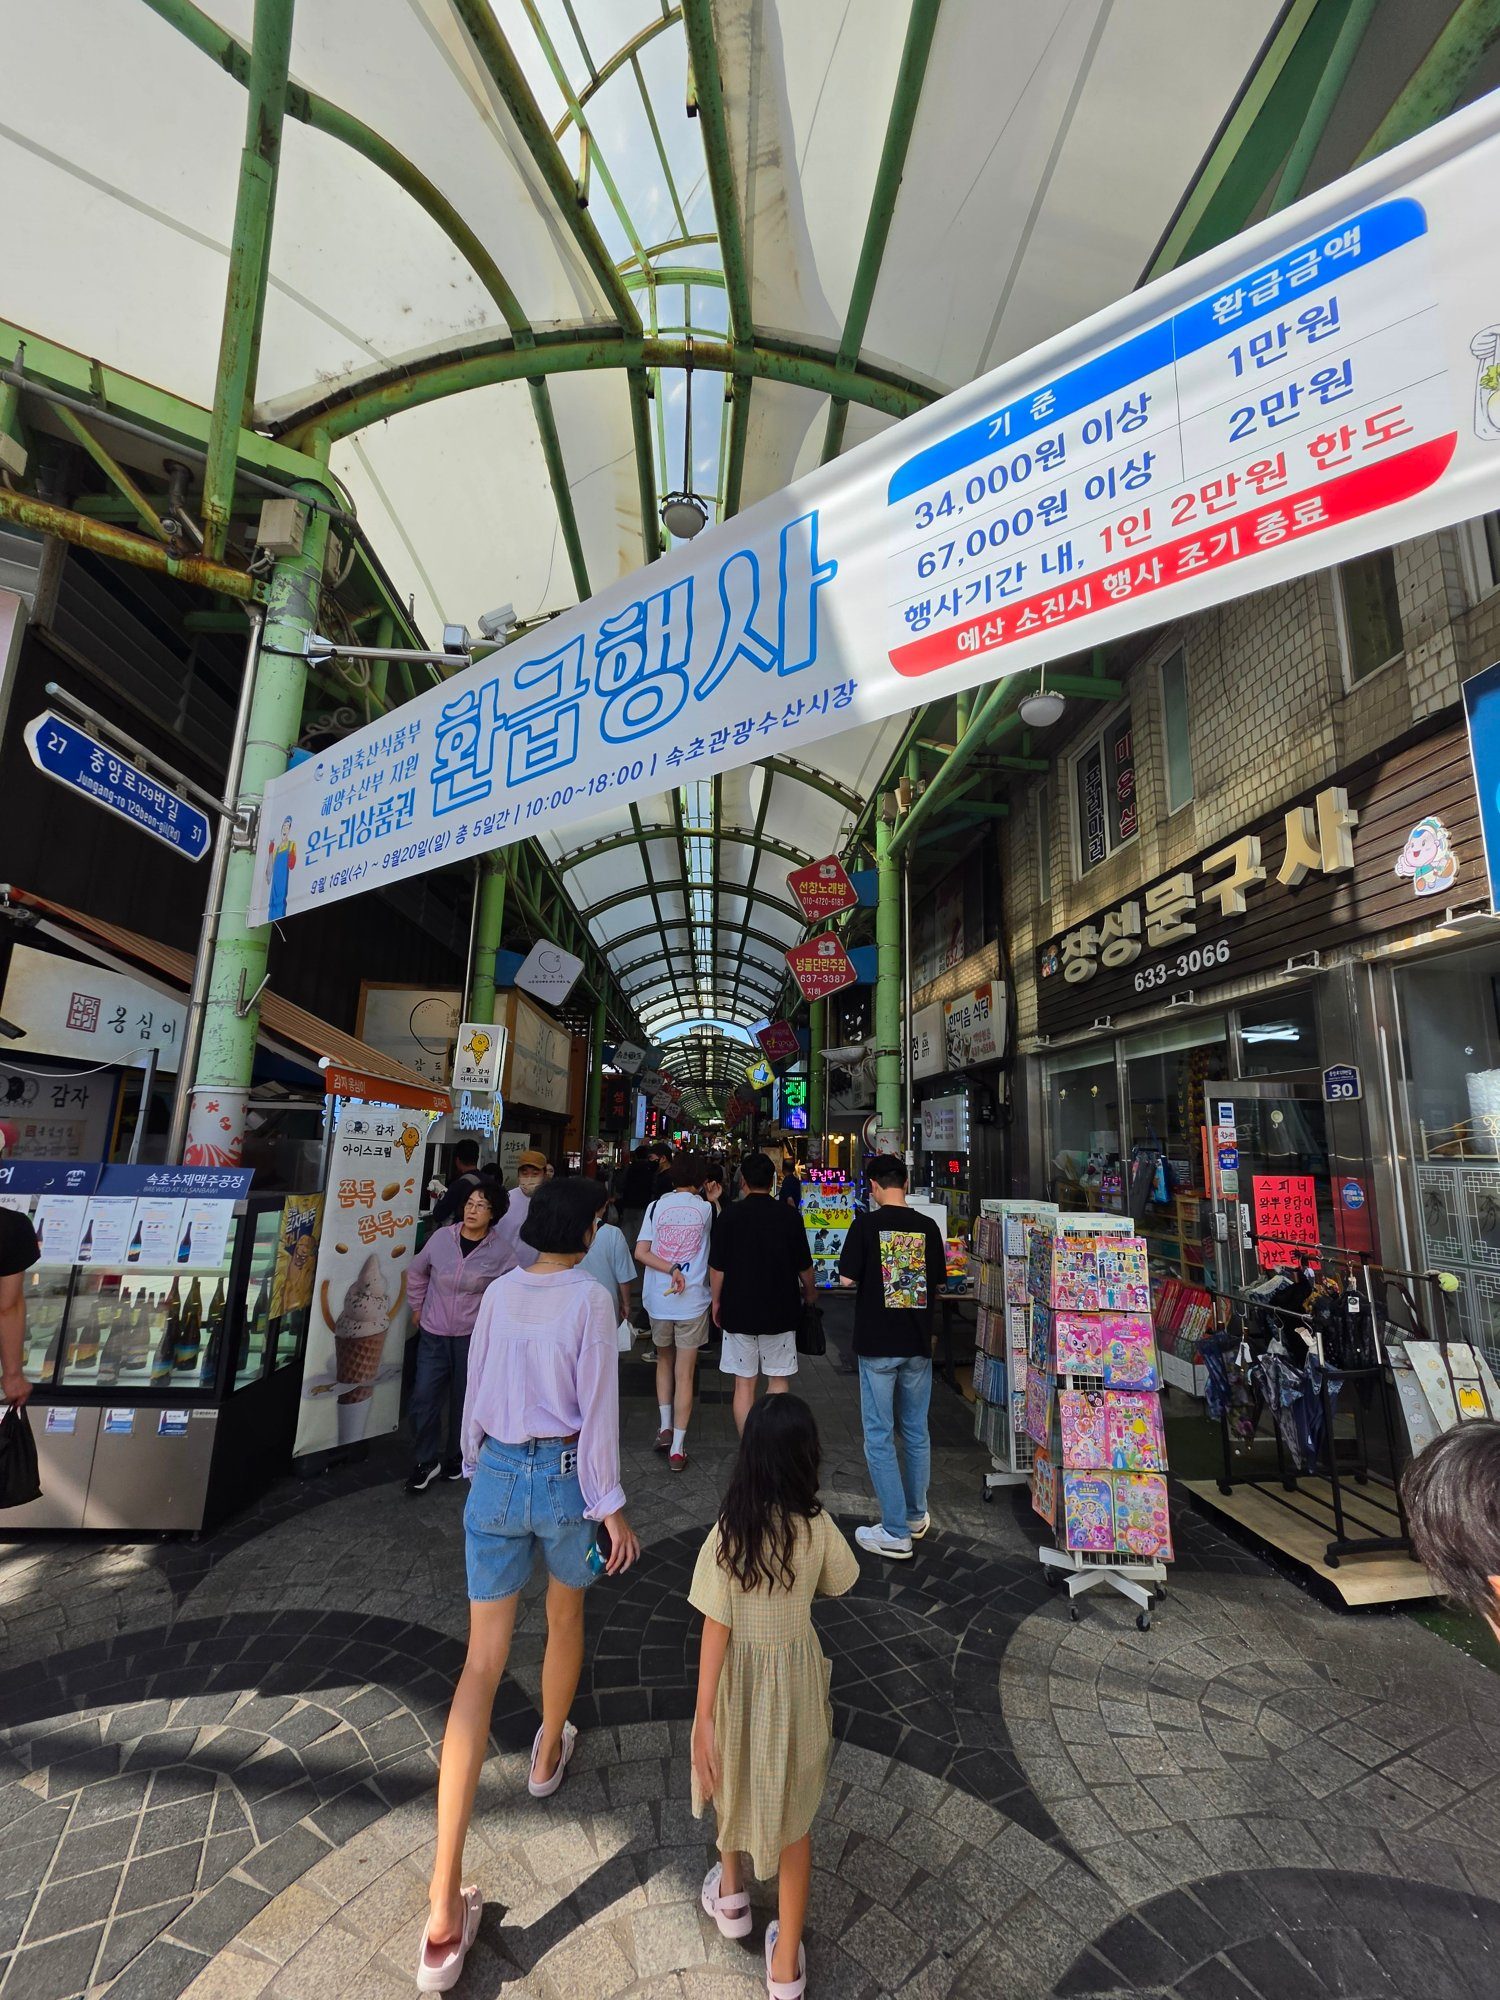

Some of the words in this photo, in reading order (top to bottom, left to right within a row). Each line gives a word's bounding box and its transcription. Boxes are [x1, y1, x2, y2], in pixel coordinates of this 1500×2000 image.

[1212, 224, 1361, 326] 환급금액
[1228, 295, 1341, 377] 1만원
[1229, 358, 1354, 443] 2만원
[914, 432, 1067, 530] 34,000원
[1082, 392, 1152, 445] 이상
[904, 561, 1027, 632] 행사기간
[1041, 540, 1085, 575] 내,
[1100, 507, 1152, 554] 1인
[1171, 451, 1287, 528] 2만원
[1307, 404, 1414, 471] 한도
[917, 489, 1068, 578] 67,000원
[1085, 451, 1156, 501] 이상
[957, 617, 1005, 652] 예산
[1015, 583, 1092, 633] 소진시
[1102, 557, 1164, 599] 행사
[1177, 526, 1240, 575] 조기
[1254, 496, 1329, 545] 종료
[430, 509, 839, 817] 환급행사
[47, 732, 68, 754] 27
[329, 720, 421, 785] 농림축산식품부
[76, 770, 125, 808] Jungang-ro
[127, 799, 181, 843] 129beon-gil(Rd)
[90, 748, 179, 822] 중앙로129번길
[311, 876, 326, 895] 9월
[329, 861, 368, 888] 16일(수)
[382, 830, 451, 869] 9월20일(일)
[456, 824, 468, 844] 총
[473, 809, 510, 837] 5일간
[526, 760, 643, 818] 10:00~18:00
[666, 679, 858, 767] 속초관광수산시장
[320, 770, 384, 817] 해양수산부
[390, 753, 419, 785] 지원
[1115, 730, 1137, 839] 미용실
[191, 825, 202, 842] 31
[305, 787, 416, 866] 온누리상품권
[799, 881, 847, 895] 선창노래방
[1061, 786, 1360, 983] 창성문구사
[800, 974, 846, 983] 637-3387
[1134, 939, 1231, 992] 633-3066
[107, 1005, 176, 1044] 옹심이
[973, 997, 990, 1022] 식당
[51, 1083, 89, 1110] 감자
[1331, 1083, 1353, 1097] 30
[342, 1144, 392, 1158] 아이스크림
[375, 1124, 395, 1136] 감자
[146, 1172, 245, 1188] 속초수제맥주공장
[337, 1179, 376, 1208] 쫀득
